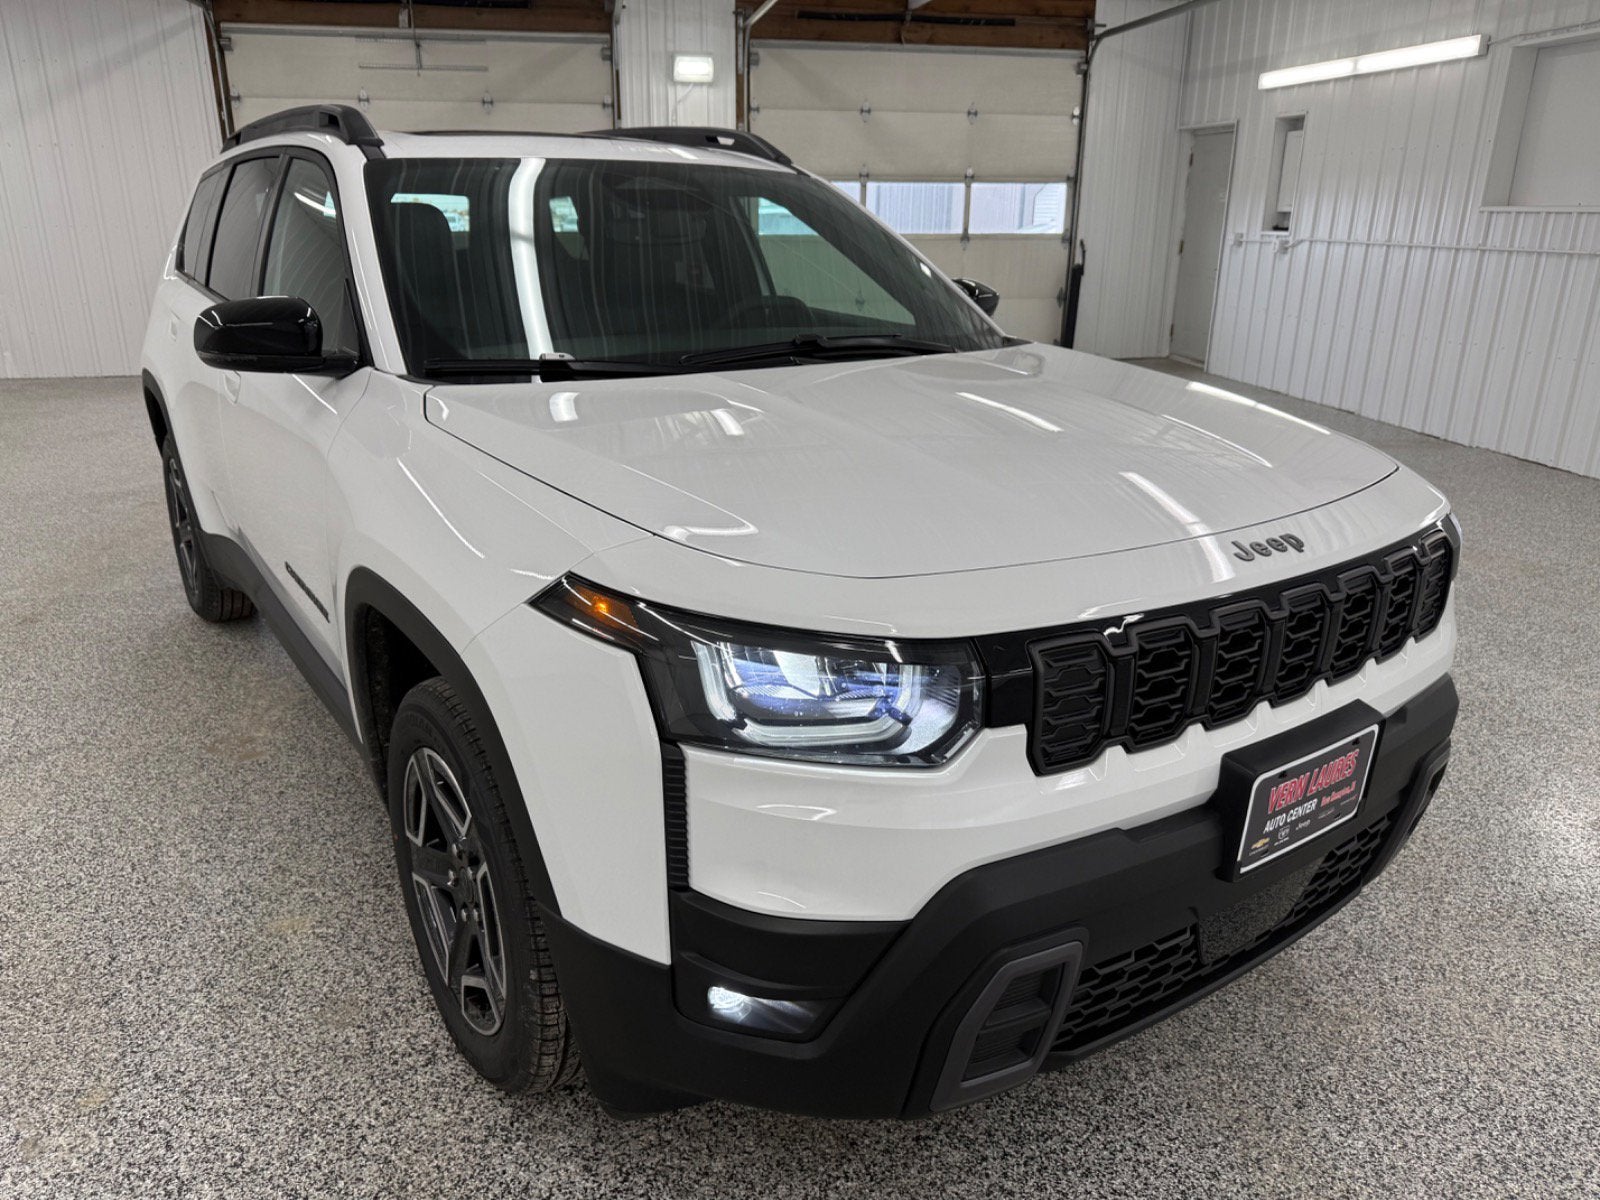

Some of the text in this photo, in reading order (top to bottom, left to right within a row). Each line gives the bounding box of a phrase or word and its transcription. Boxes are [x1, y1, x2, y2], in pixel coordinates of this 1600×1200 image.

[1231, 533, 1305, 562] Jeep
[1268, 772, 1310, 814] VERN
[1307, 748, 1360, 796] LAURES
[1263, 813, 1286, 834] AUTO
[1287, 798, 1318, 822] CENTER
